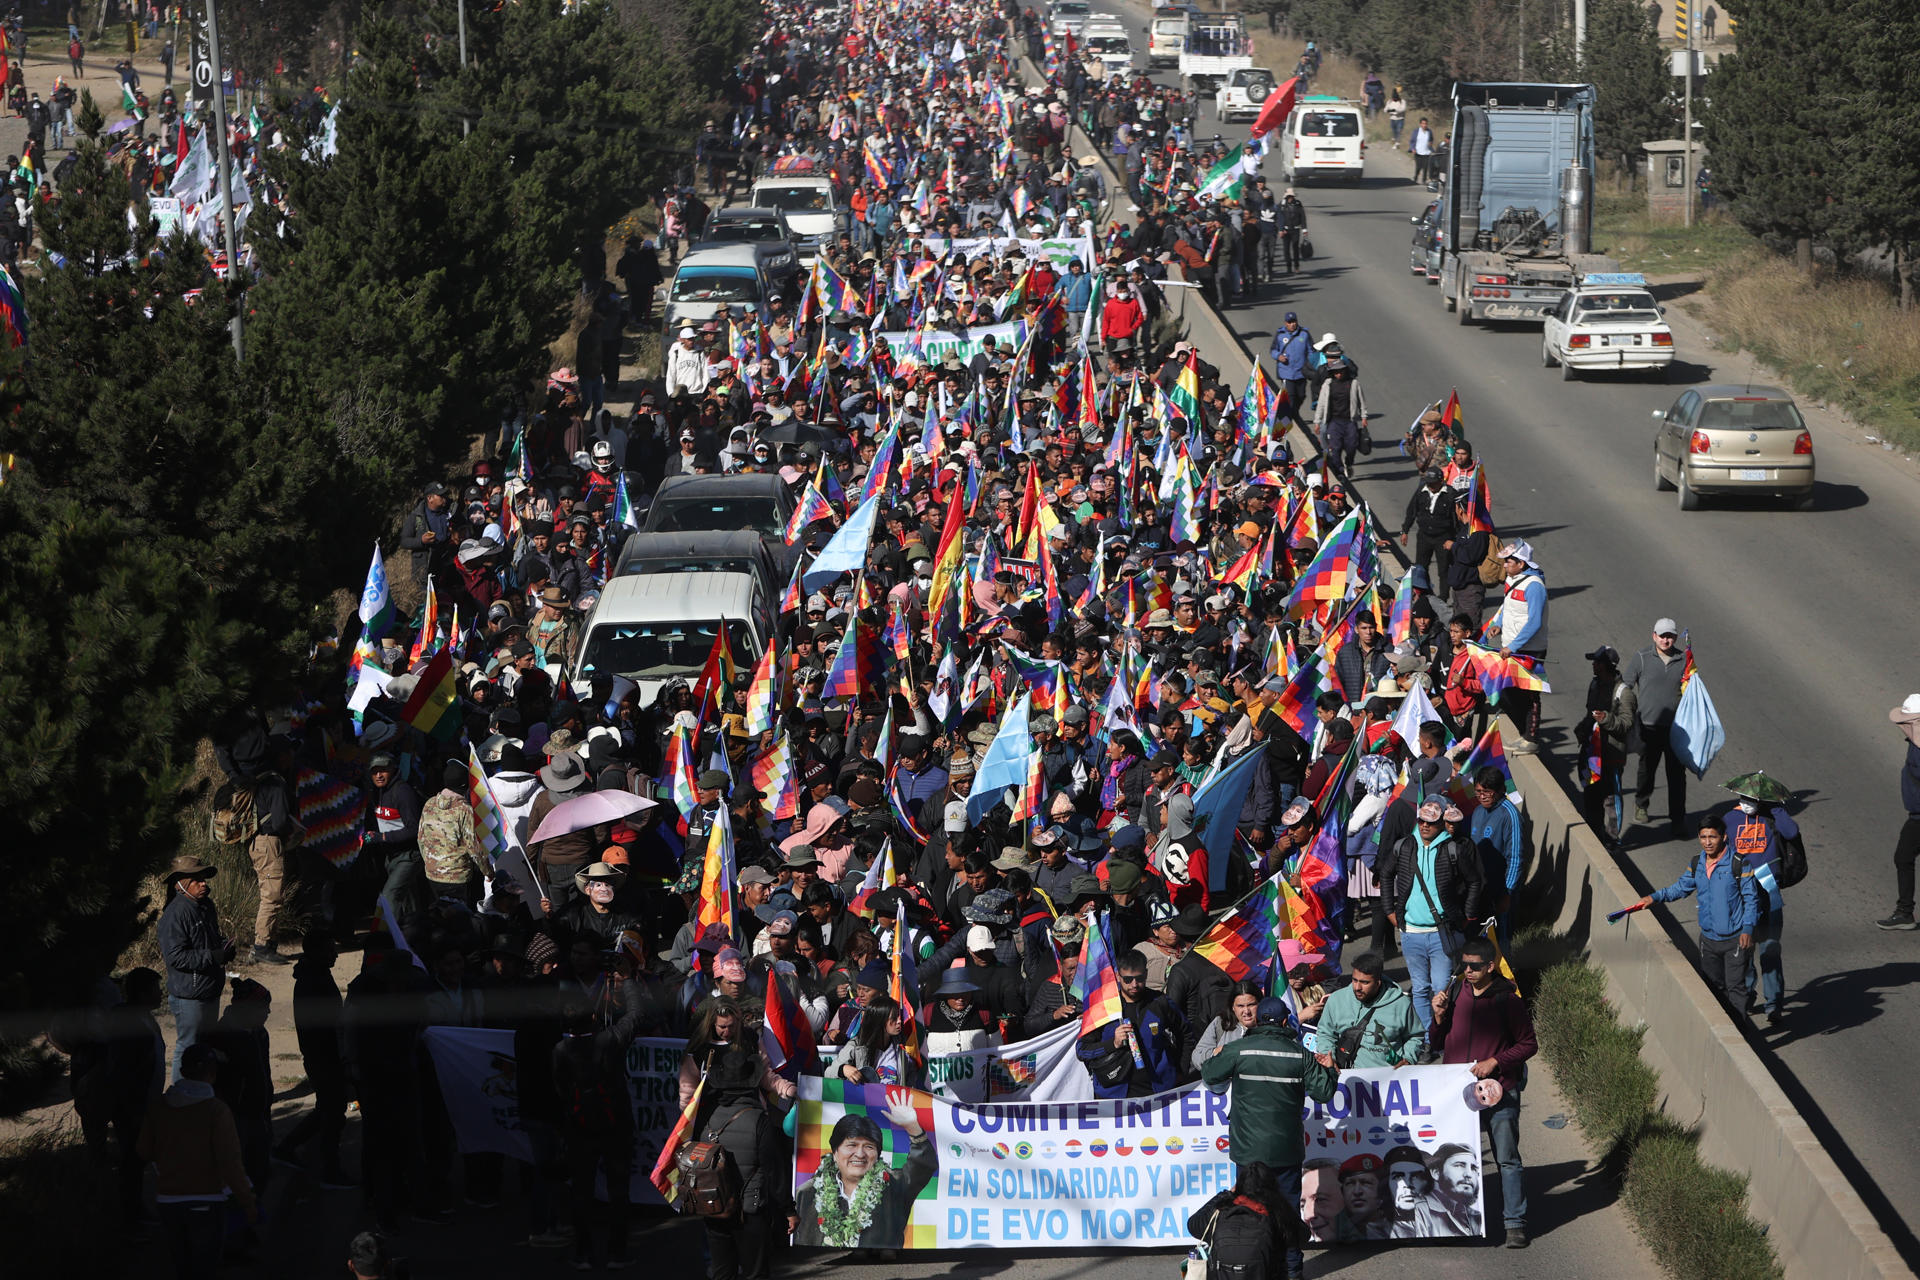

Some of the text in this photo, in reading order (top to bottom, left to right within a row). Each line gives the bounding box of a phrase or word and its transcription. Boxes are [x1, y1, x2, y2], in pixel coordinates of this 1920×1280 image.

[1484, 303, 1522, 319] Quality
[1523, 306, 1535, 317] in
[626, 1042, 686, 1072] ÓN ESP
[632, 1106, 669, 1130] DA
[951, 1101, 1100, 1134] COMITE
[948, 1168, 979, 1198] EN
[986, 1165, 1139, 1200] SOLIDARIDAD
[1147, 1164, 1162, 1197] Y
[948, 1207, 990, 1240] DE
[1002, 1208, 1069, 1240] EVO
